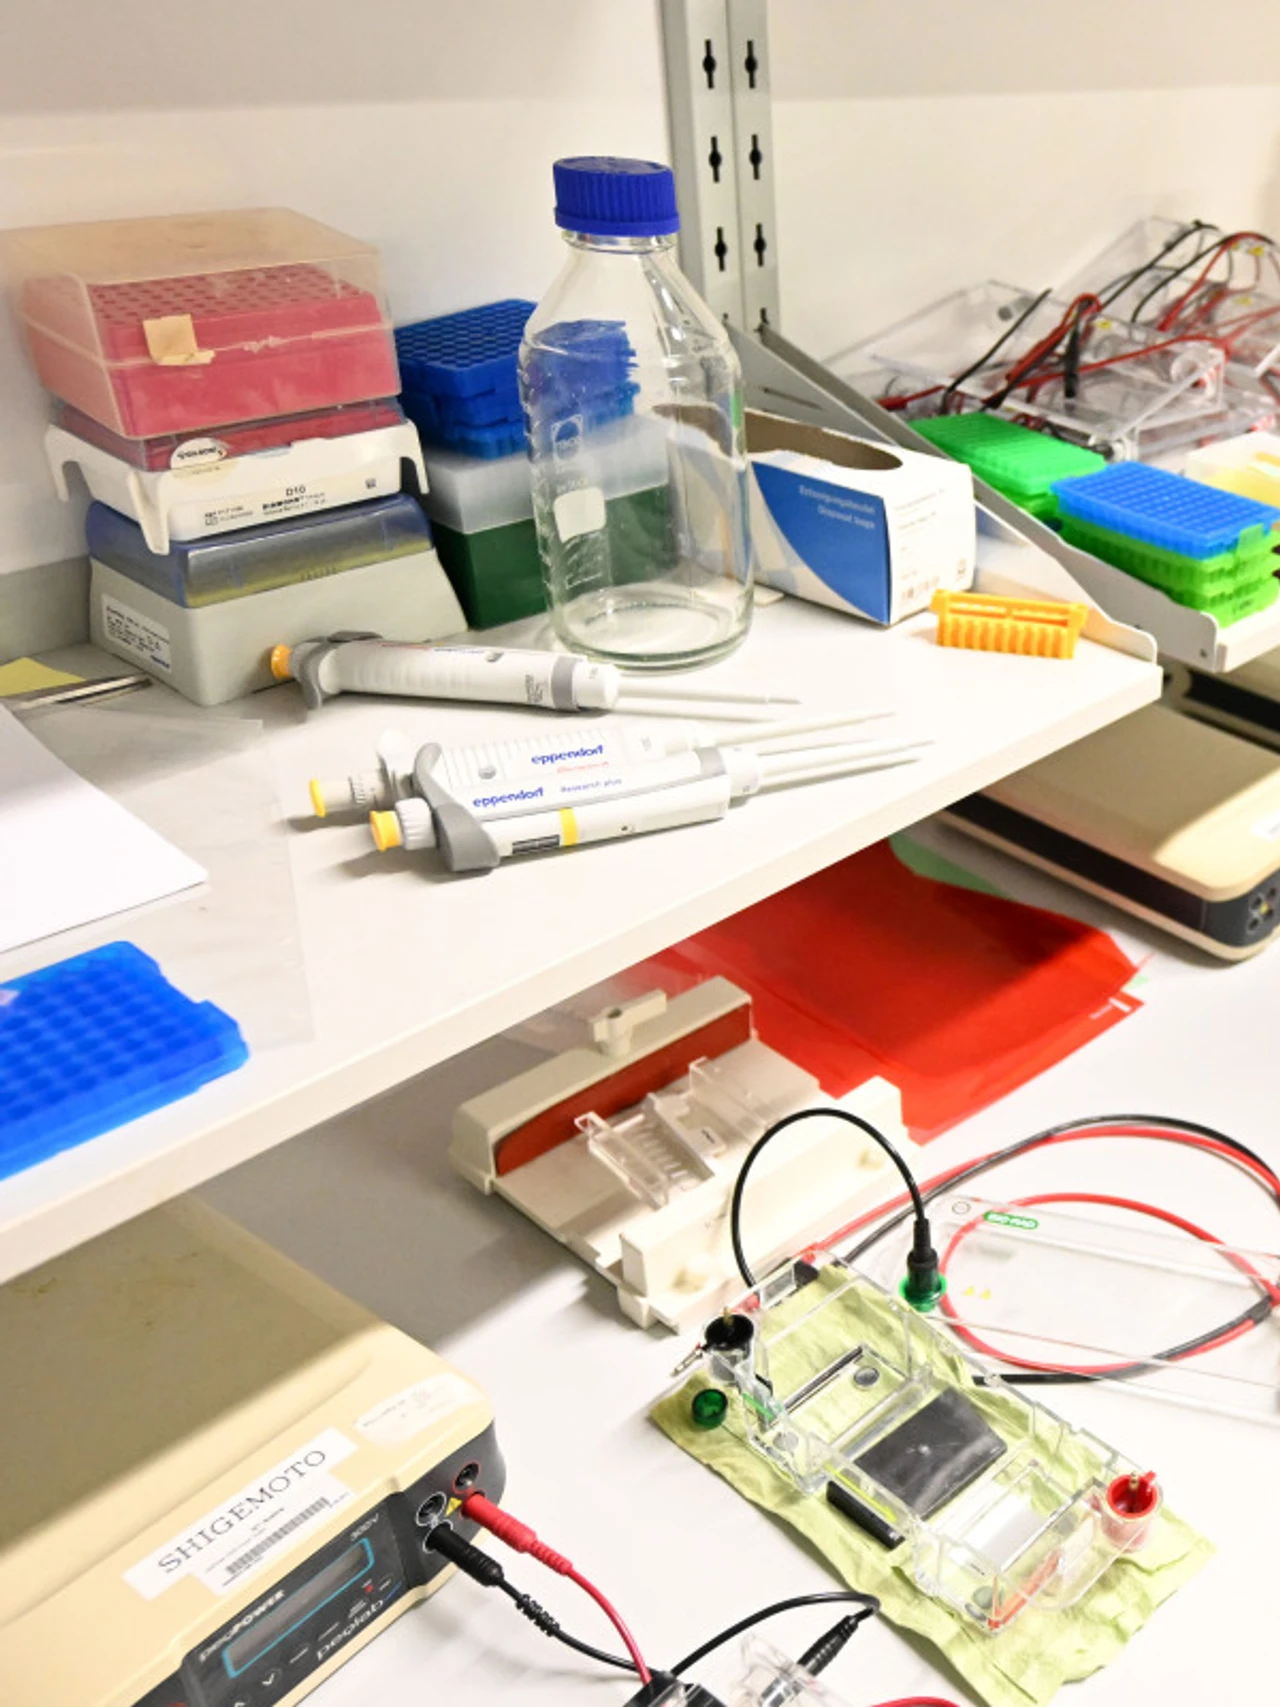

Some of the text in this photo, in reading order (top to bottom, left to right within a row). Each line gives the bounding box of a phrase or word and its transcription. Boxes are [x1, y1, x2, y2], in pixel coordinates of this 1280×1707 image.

[531, 744, 604, 765] eppendorf
[473, 787, 544, 808] eppendorf
[158, 1450, 326, 1574] SHIGEMOTO
[316, 1599, 384, 1661] peqlab
